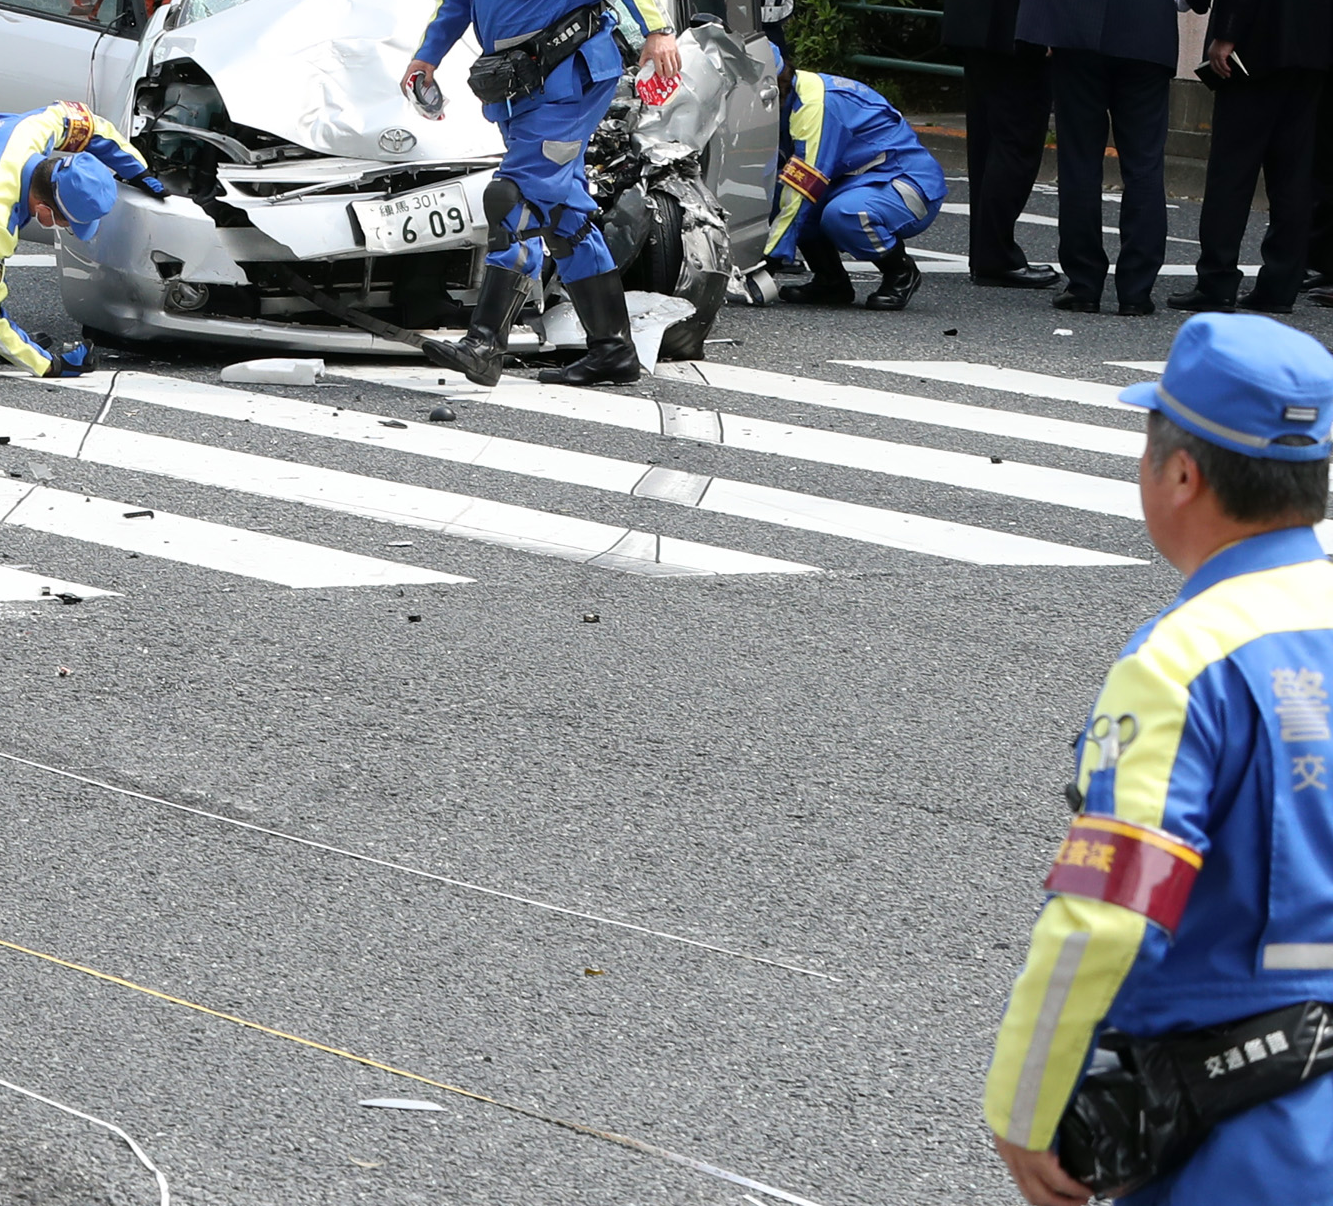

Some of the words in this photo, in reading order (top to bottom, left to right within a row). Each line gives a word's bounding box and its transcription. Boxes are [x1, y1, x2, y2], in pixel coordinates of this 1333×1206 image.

[379, 200, 410, 217] 練馬
[413, 194, 438, 210] 301
[1271, 667, 1332, 741] 警
[1291, 754, 1327, 791] 交
